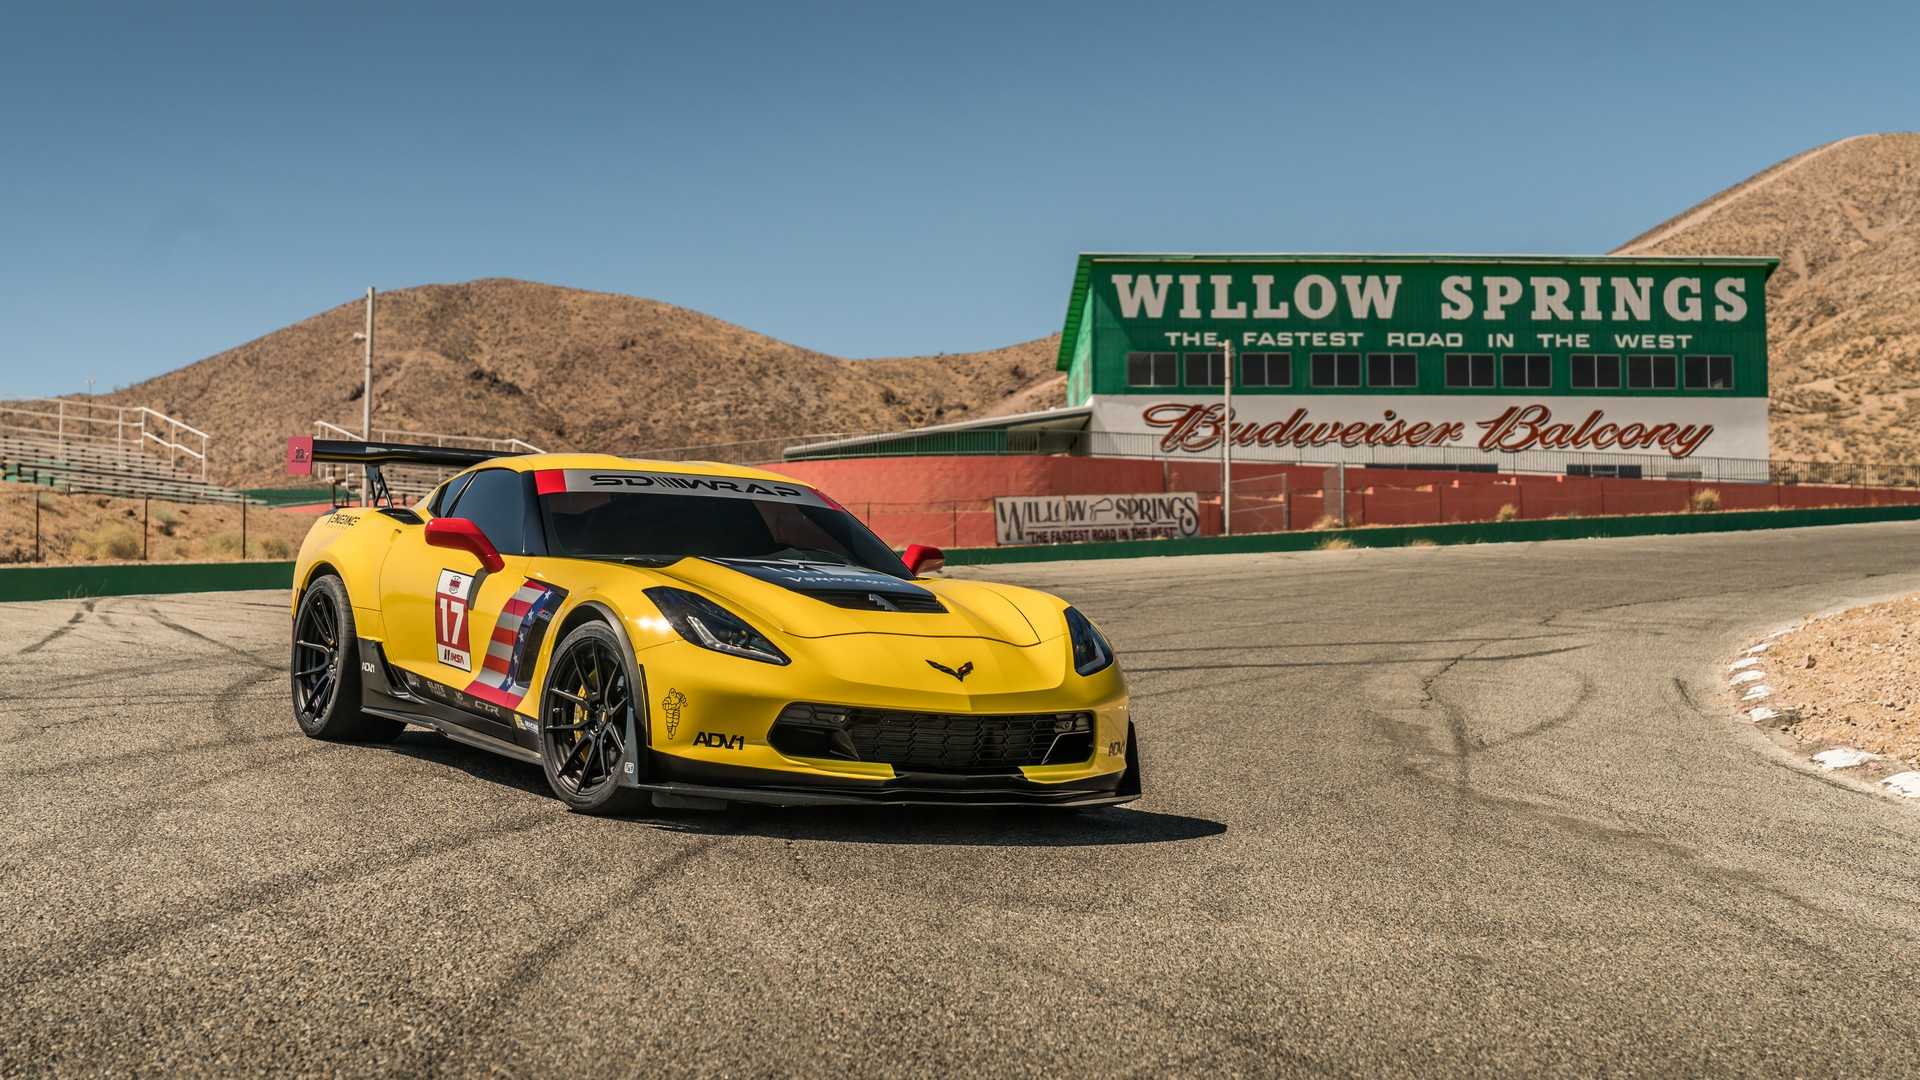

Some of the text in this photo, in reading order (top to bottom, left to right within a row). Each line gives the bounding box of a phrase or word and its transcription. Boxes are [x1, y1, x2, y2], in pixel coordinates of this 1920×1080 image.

[1111, 274, 1748, 322] WILLOW SPRINGS
[1164, 332, 1693, 348] THE FASTEST ROAD IN THE WEST
[1142, 402, 1714, 458] Budweiser Balcony
[999, 496, 1200, 541] WILLOW SPRINGS
[1050, 529, 1089, 543] FASTEST
[1092, 528, 1116, 541] ROAD
[1118, 528, 1130, 540] IN
[1131, 527, 1148, 540] THE
[440, 598, 465, 645] 17
